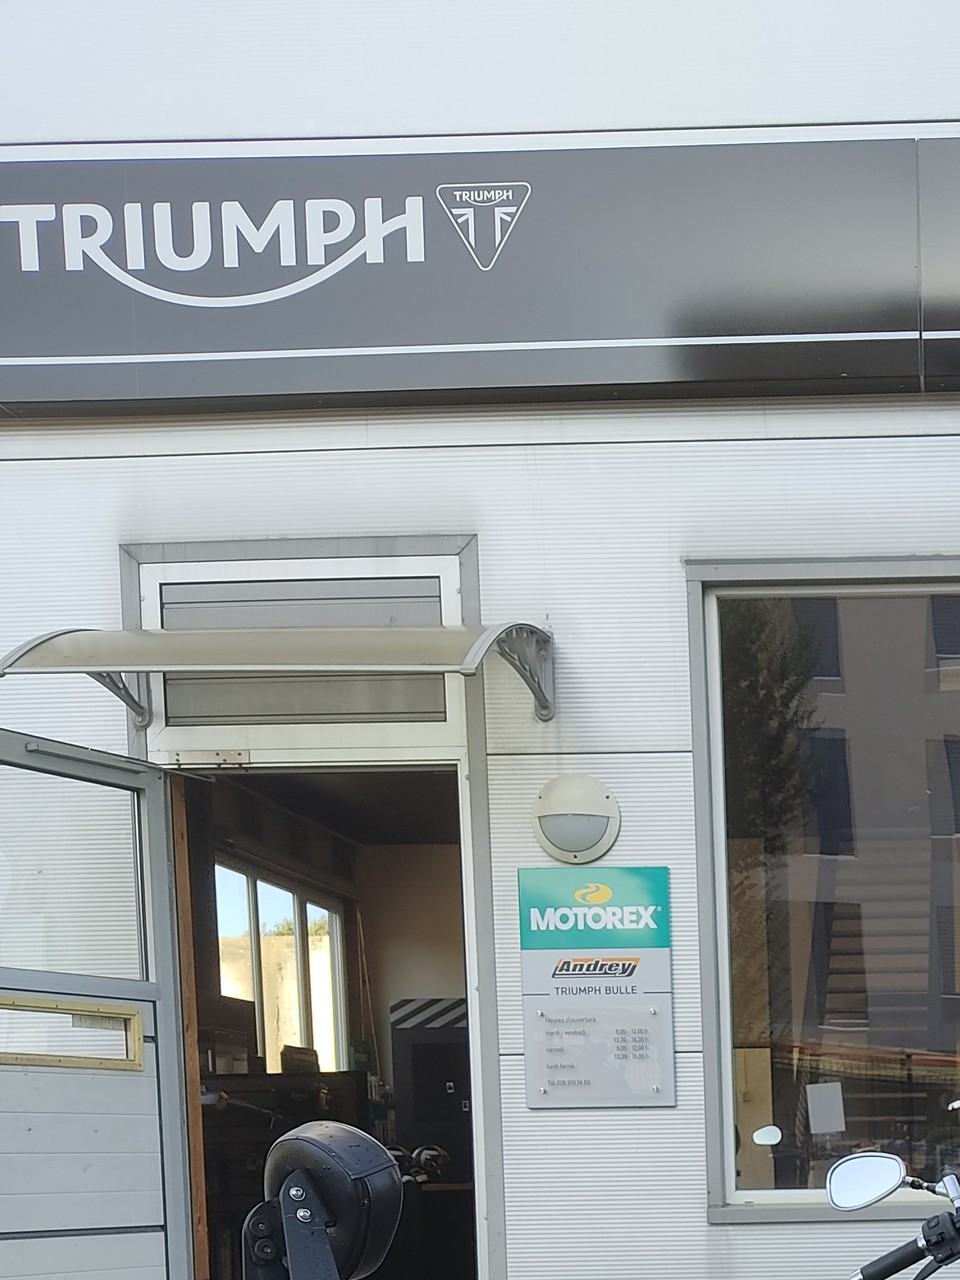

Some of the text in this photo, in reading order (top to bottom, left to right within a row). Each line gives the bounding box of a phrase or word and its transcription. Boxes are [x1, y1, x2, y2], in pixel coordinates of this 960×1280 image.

[453, 190, 513, 205] TRIUMPH
[0, 196, 426, 307] TRIUMPH
[530, 905, 658, 931] MOTOREX
[557, 959, 634, 976] Andrey
[554, 985, 638, 996] TRIUMPH BULLE
